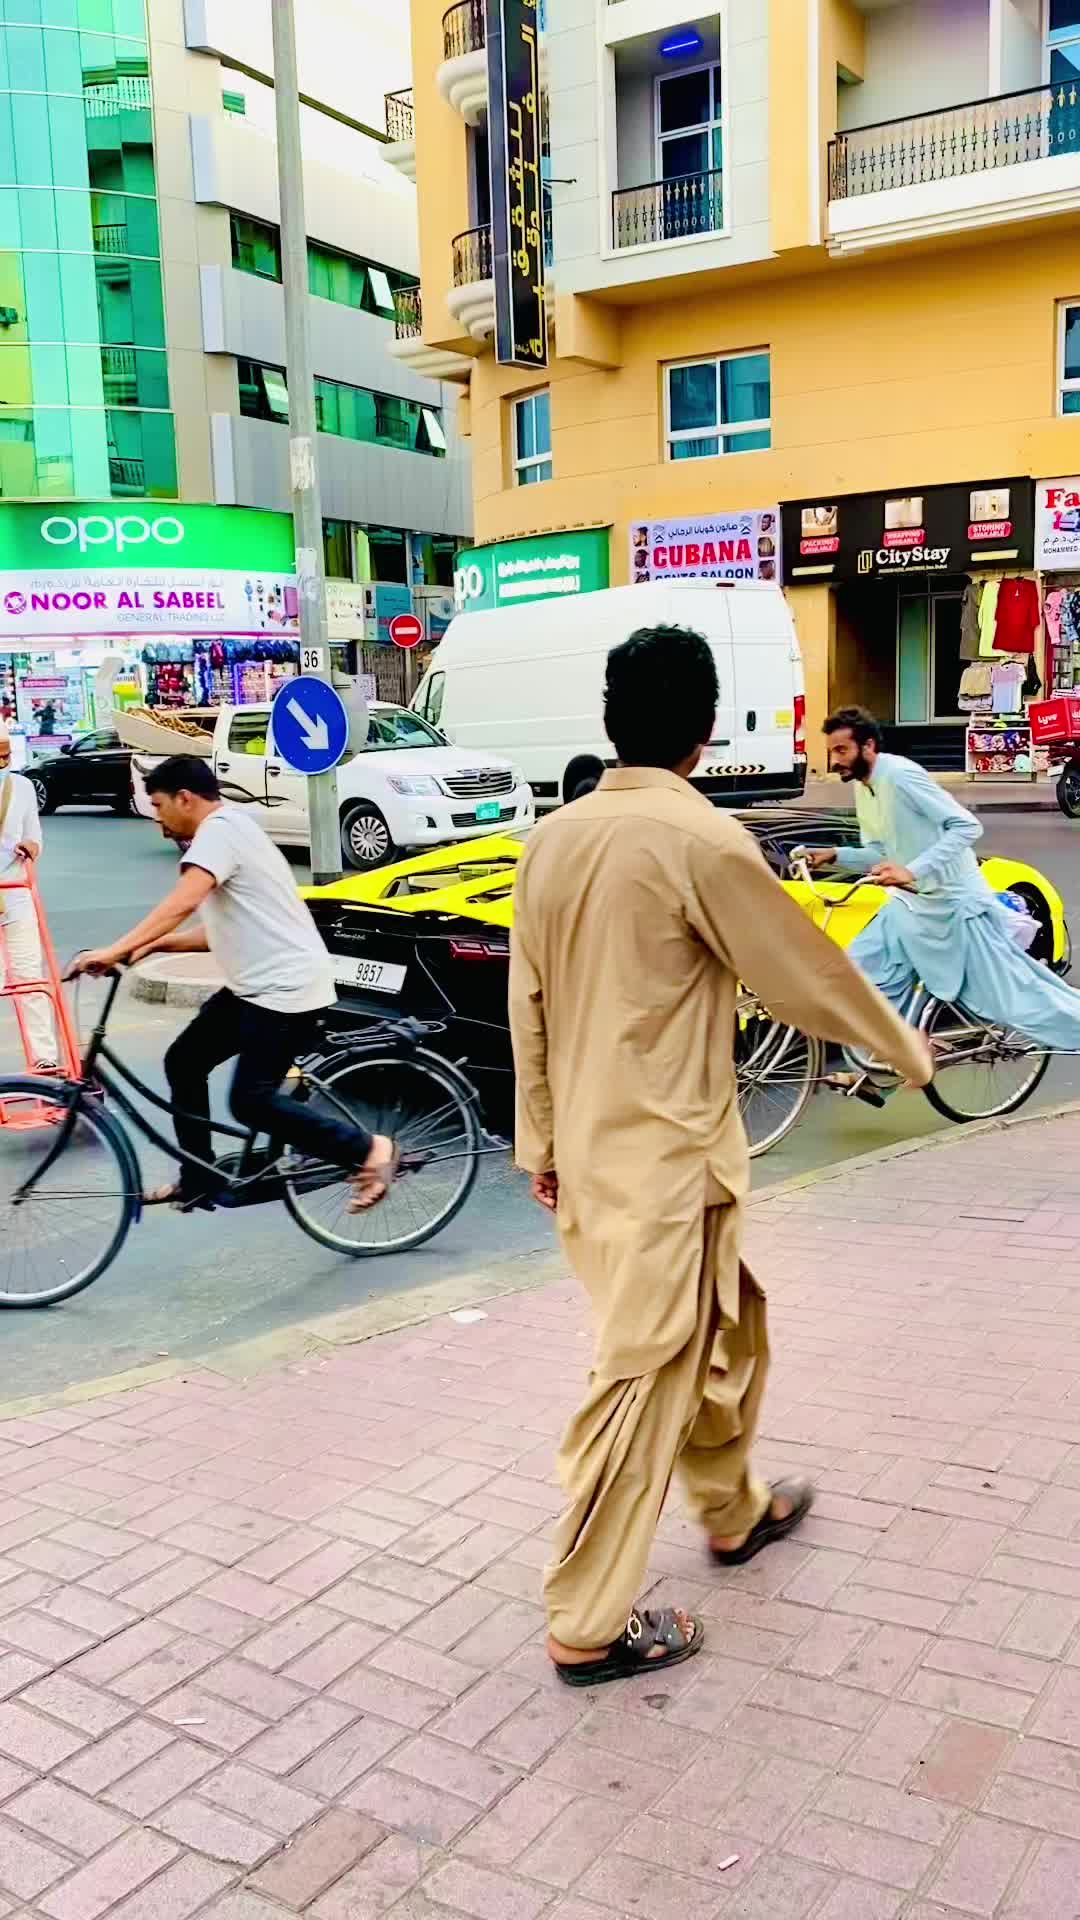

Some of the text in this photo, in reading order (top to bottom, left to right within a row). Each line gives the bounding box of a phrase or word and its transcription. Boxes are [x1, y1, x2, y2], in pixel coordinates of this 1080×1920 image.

[40, 515, 185, 553] oppo
[652, 538, 753, 569] CUBANA
[875, 546, 951, 566] CityStay
[31, 591, 225, 611] NOOR AL SABEEL
[116, 612, 164, 623] GENERAL
[304, 650, 319, 668] 36
[355, 962, 384, 984] 9857
